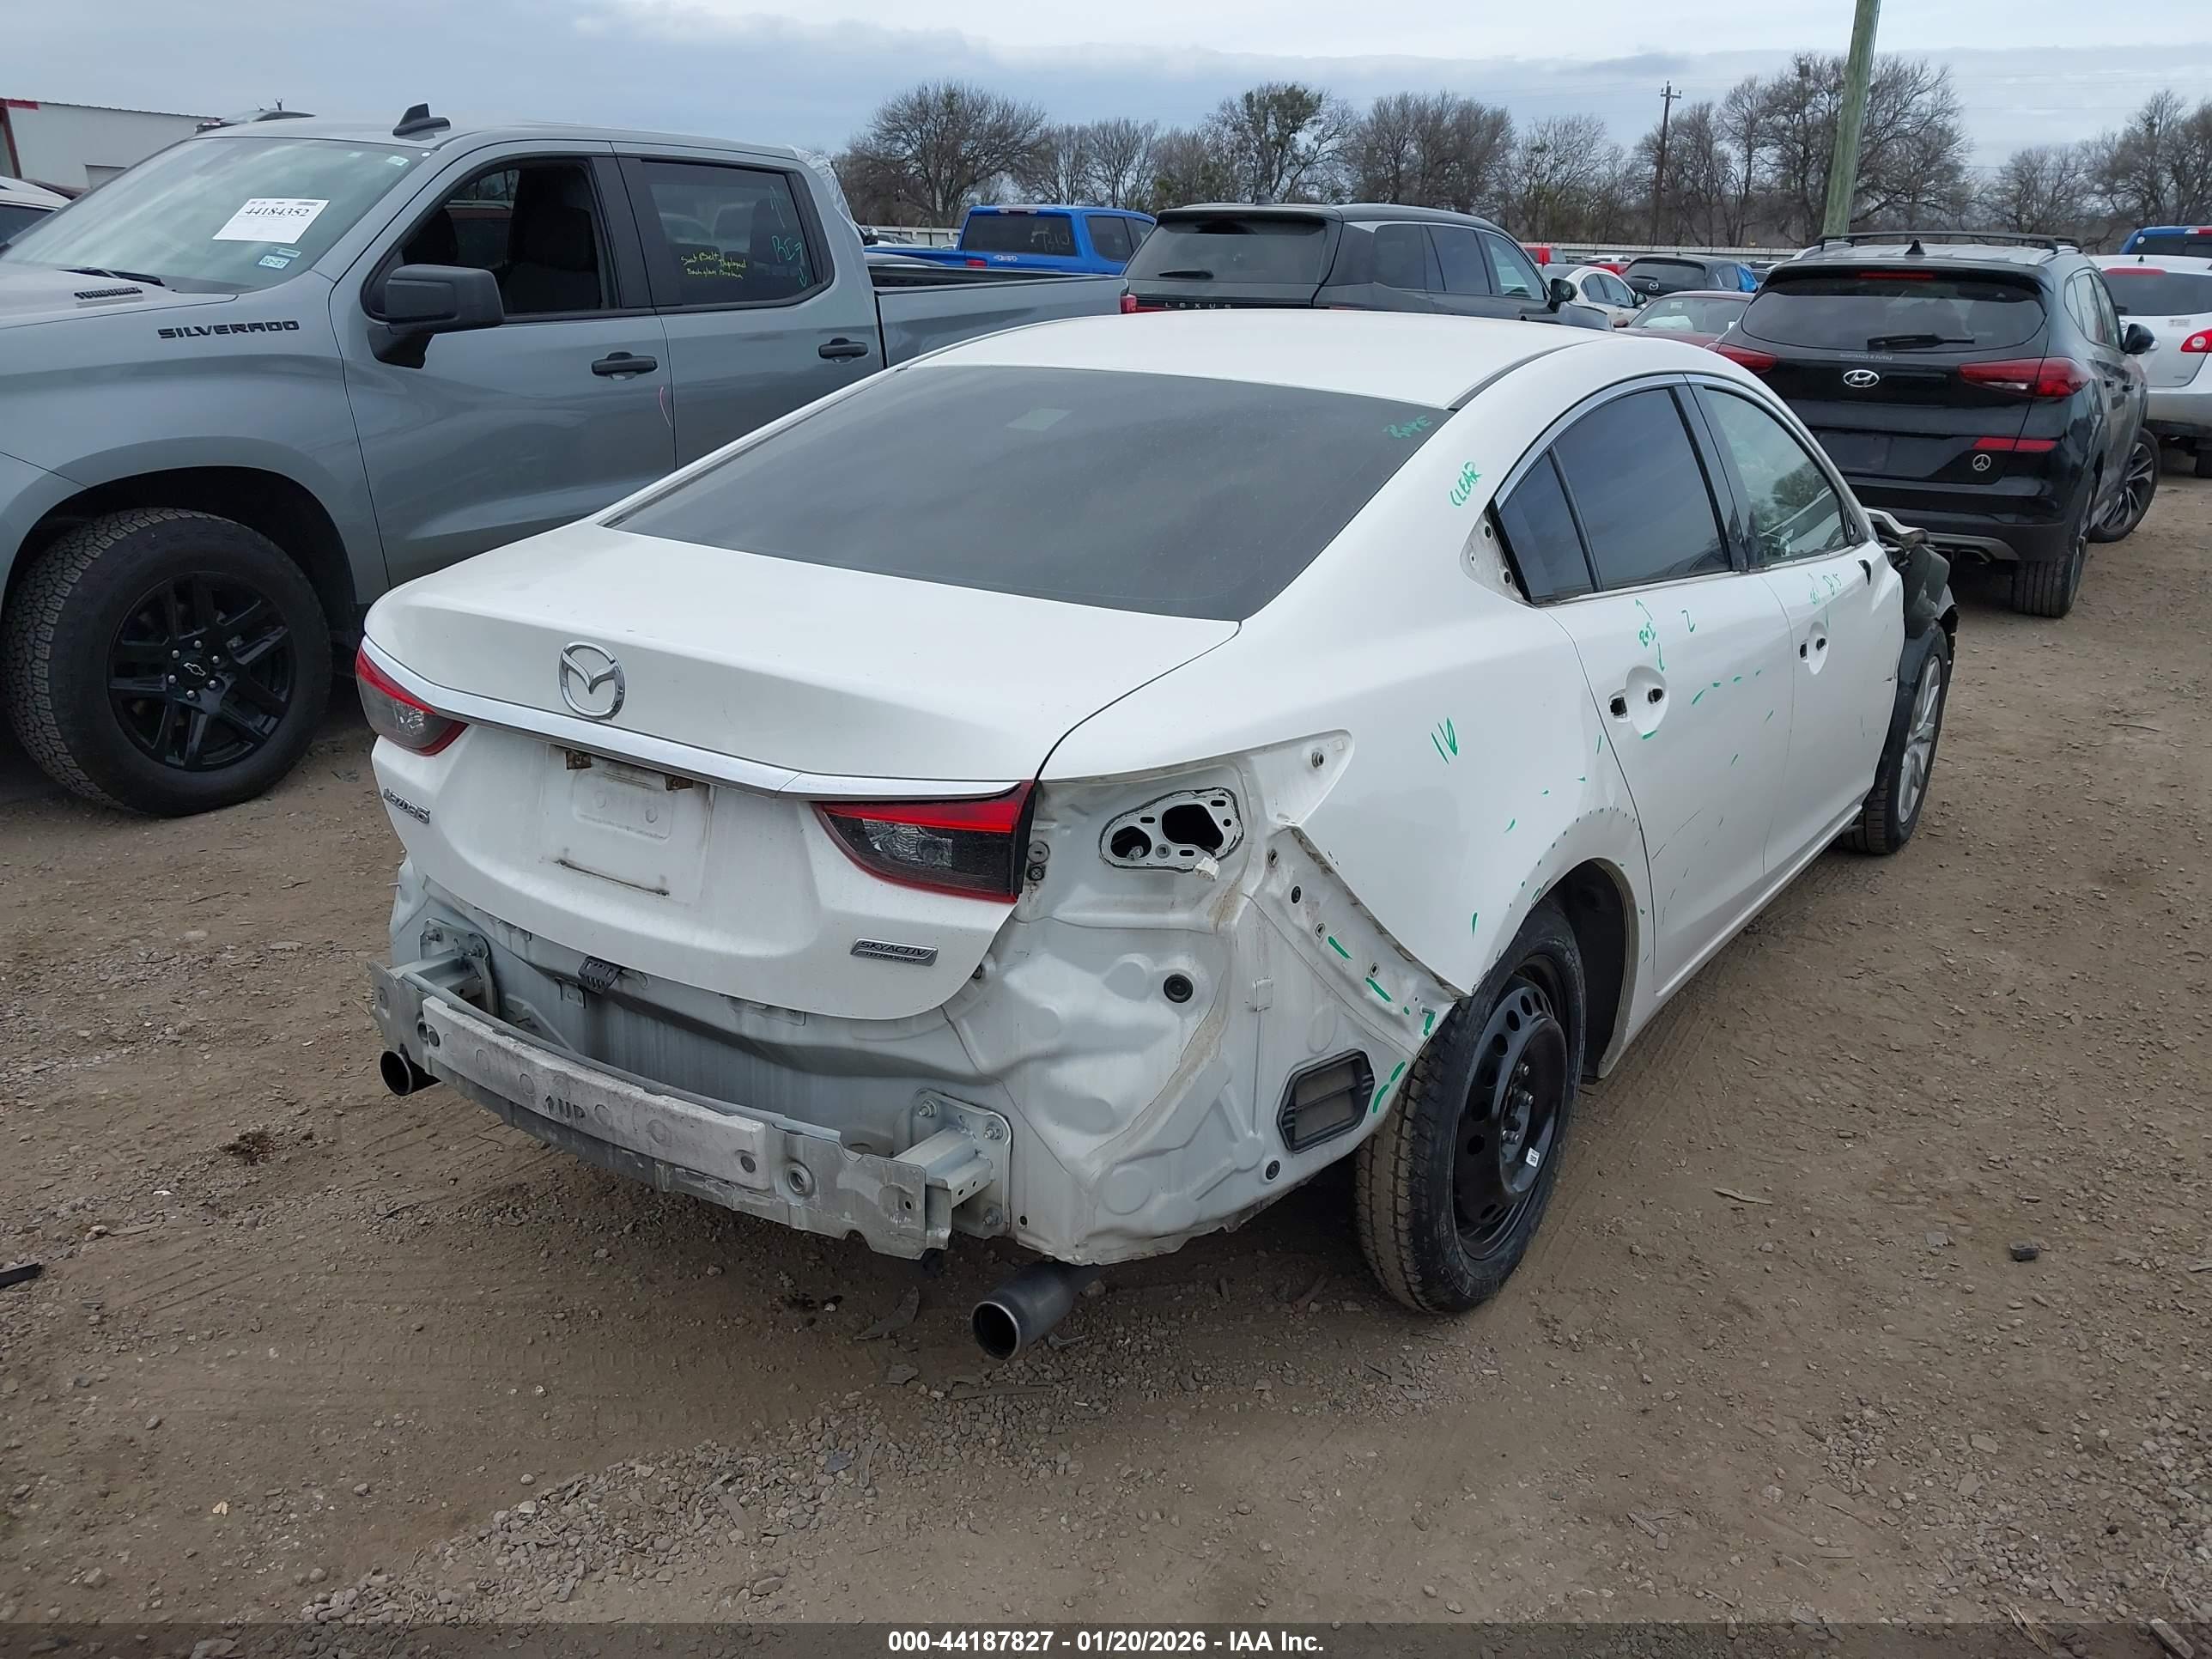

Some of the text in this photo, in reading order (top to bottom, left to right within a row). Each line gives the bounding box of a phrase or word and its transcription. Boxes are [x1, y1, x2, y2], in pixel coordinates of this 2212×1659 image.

[246, 206, 310, 217] 44184352
[698, 252, 720, 263] Belt
[1165, 301, 1232, 310] LEXUS
[157, 320, 300, 339] SILVERADO
[1449, 461, 1482, 507] CLEAR
[859, 941, 927, 956] SKYACTIV
[558, 1098, 586, 1121] UP
